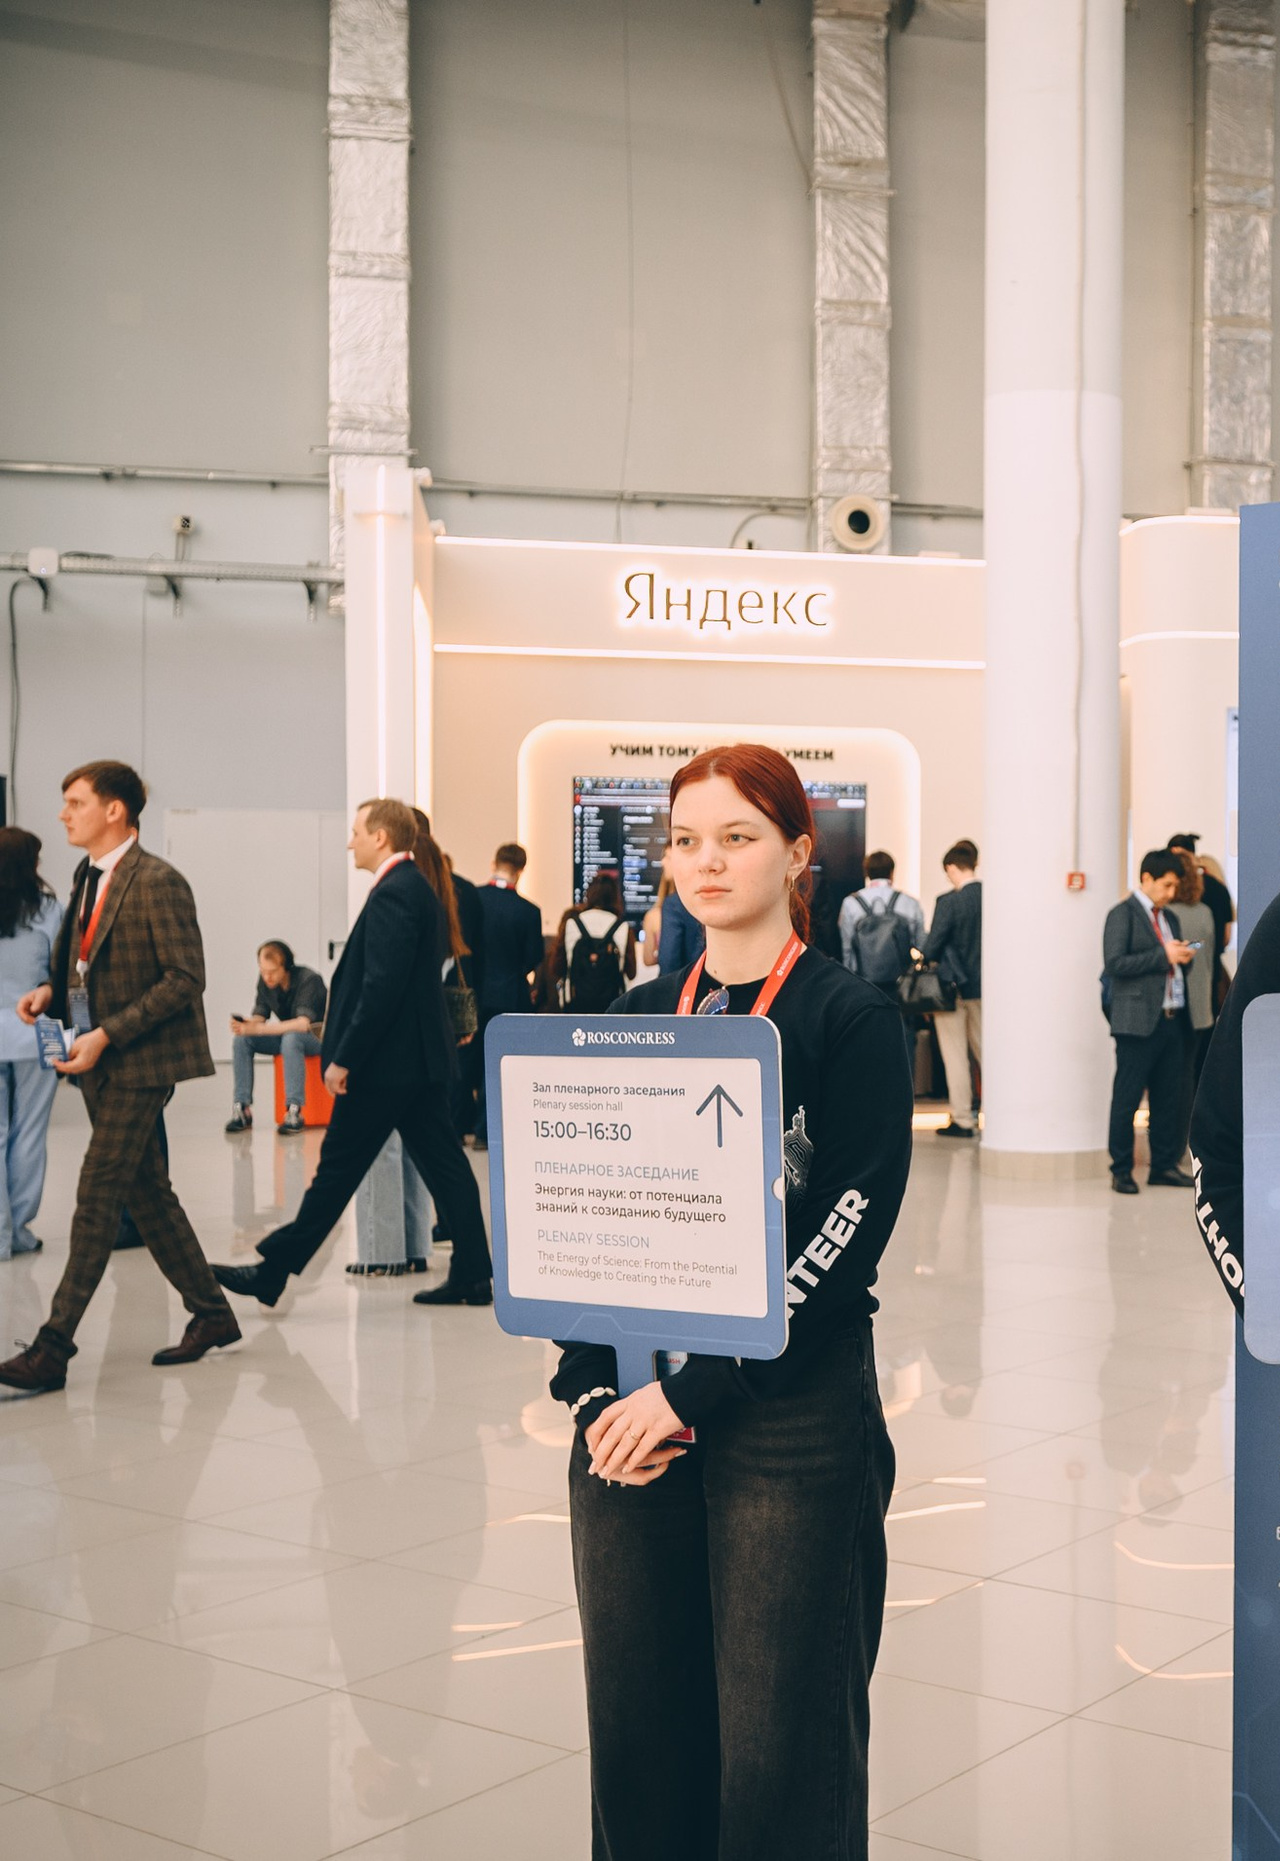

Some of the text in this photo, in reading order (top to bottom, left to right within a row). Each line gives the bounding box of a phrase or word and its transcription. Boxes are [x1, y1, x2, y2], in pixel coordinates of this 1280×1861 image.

[624, 572, 828, 631] Яндекс
[611, 744, 698, 757] УЧИМ ТОМУ
[785, 749, 835, 761] УМЕЕМ
[587, 1031, 675, 1046] ROSCONGRESS
[532, 1082, 686, 1098] Зал пленарного заседания
[533, 1099, 624, 1112] Plenary session hall
[534, 1161, 700, 1182] ПЛЕНАРНОЕ ЗАСЕДАНИЕ
[534, 1183, 723, 1206] Энергия науки: от потенциала
[535, 1201, 727, 1224] знаний к созиданию будущего
[537, 1229, 650, 1249] PLENARY SESSION
[538, 1251, 738, 1275] The Energy of Science: From the Potential
[538, 1265, 712, 1288] of Knowledge to Creating the Future
